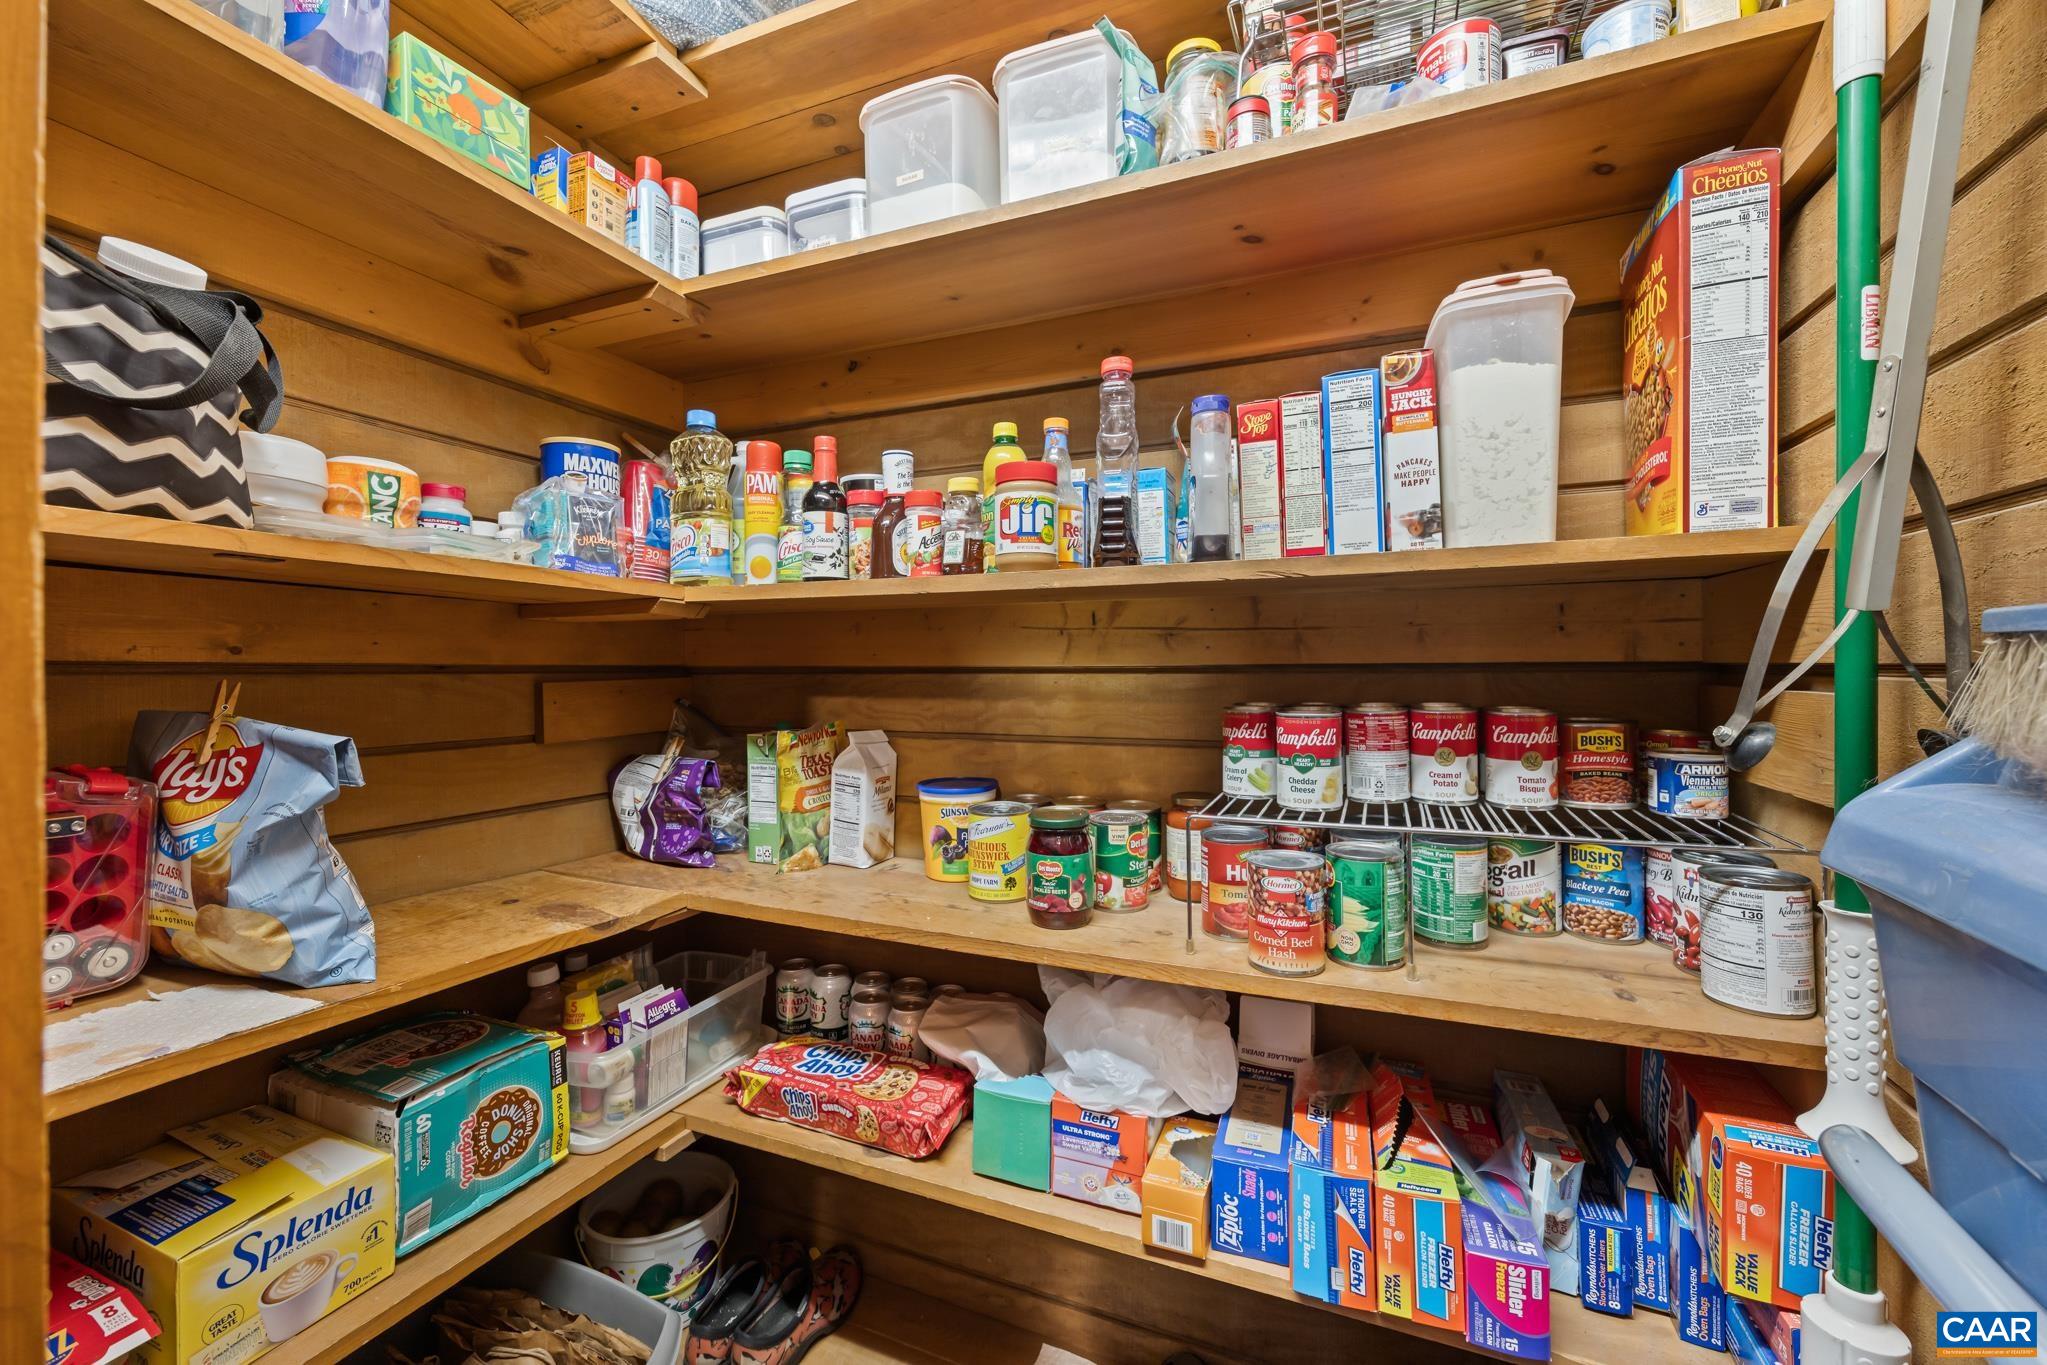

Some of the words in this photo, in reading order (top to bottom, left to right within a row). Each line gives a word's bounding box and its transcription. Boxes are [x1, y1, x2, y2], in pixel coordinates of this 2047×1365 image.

[1719, 164, 1745, 174] Honey
[1747, 160, 1763, 169] Nut
[1692, 168, 1768, 195] Cheerios
[1738, 213, 1750, 221] 140
[1757, 210, 1769, 219] 210
[1623, 276, 1667, 353] Cheerios
[1864, 292, 1880, 350] LIBMAN
[1391, 388, 1432, 401] HUNGRY
[1330, 404, 1353, 412] Calories
[1358, 399, 1372, 408] 200
[1241, 411, 1272, 434] Stove
[1252, 424, 1269, 438] Top
[564, 453, 619, 477] MAXWE
[1396, 457, 1433, 470] PANCAKES
[1394, 472, 1411, 480] MAKE
[1412, 468, 1436, 478] PEOPLE
[1401, 478, 1431, 488] HAPPY
[589, 474, 619, 496] HOUS
[746, 474, 777, 494] PAM
[372, 473, 400, 528] ANG
[1002, 502, 1052, 534] Jif
[645, 550, 659, 559] 30
[779, 541, 802, 561] Crisc
[1412, 722, 1476, 747] Campbell's
[1581, 735, 1622, 747] BUSH'S
[800, 752, 832, 767] TEXAS
[1573, 754, 1629, 765] Homestyle
[157, 749, 247, 803] Lay's
[1429, 771, 1451, 780] Cream
[1453, 771, 1462, 780] of
[1681, 765, 1728, 775] ARMOU
[1288, 777, 1318, 786] Cheddar
[1433, 779, 1459, 788] Potato
[1517, 776, 1547, 784] Tomato
[1519, 784, 1546, 794] Bisque
[1681, 775, 1710, 786] Vienna
[1290, 786, 1316, 794] Cheese
[941, 808, 968, 818] SUNSW
[973, 860, 996, 870] STEW
[1570, 847, 1622, 868] BUSH'S
[1221, 889, 1249, 899] Toma
[1267, 881, 1298, 890] Hormel
[1566, 880, 1606, 894] Blackeye
[1608, 885, 1631, 898] Peas
[1676, 885, 1699, 902] Kidn
[1593, 898, 1615, 907] BACON
[1257, 914, 1276, 928] Mary
[1741, 910, 1764, 920] 130
[1253, 931, 1288, 947] Corned
[1291, 935, 1314, 948] Beef
[1268, 948, 1296, 960] Hash
[648, 1000, 676, 1019] Allegra
[806, 1044, 871, 1065] Chips
[554, 1050, 563, 1085] KEURIG
[556, 1093, 563, 1105] 60
[783, 1087, 811, 1106] Chips
[416, 1113, 432, 1134] 60
[491, 1104, 526, 1126] DONUT
[522, 1100, 534, 1136] ORIGINAL
[1082, 1111, 1117, 1128] Hefty
[479, 1121, 492, 1159] COFFEE
[1062, 1125, 1082, 1135] ULTRA
[1084, 1129, 1110, 1140] STRONG
[1062, 1136, 1090, 1145] Lavender
[457, 1113, 476, 1189] Regular
[493, 1129, 524, 1161] SHOP
[1062, 1141, 1080, 1149] Sweet
[1736, 1161, 1752, 1177] 40
[1242, 1169, 1257, 1199] Snack
[1401, 1183, 1438, 1193] Hefty.com
[1735, 1175, 1743, 1194] BAGS
[1357, 1188, 1365, 1229] STRONGER
[1383, 1194, 1395, 1208] 40
[1219, 1194, 1239, 1247] Ziploc
[1789, 1201, 1798, 1234] GALLON
[217, 1186, 373, 1289] Splenda
[273, 1249, 294, 1263] ZERO
[296, 1231, 329, 1250] CALORIE
[330, 1205, 373, 1232] SWEETENER
[366, 1226, 379, 1243] #1
[1483, 1222, 1497, 1248] GALLON
[1799, 1208, 1811, 1267] FREEZER
[1817, 1219, 1833, 1268] Hefty
[1788, 1235, 1797, 1267] SLIDER
[1351, 1250, 1364, 1294] Hefty
[1428, 1237, 1437, 1288] FREEZER
[1440, 1245, 1454, 1290] Hefty
[1646, 1255, 1656, 1275] Bags
[1735, 1253, 1746, 1290] PACK
[1496, 1262, 1507, 1304] Freezer
[1747, 1253, 1758, 1294] VALUE
[343, 1278, 362, 1293] 700
[1384, 1275, 1392, 1308] PACK
[1393, 1274, 1401, 1309] VALUE
[1508, 1265, 1526, 1317] Slider
[1646, 1277, 1656, 1300] Oven
[101, 1305, 119, 1318] 8
[1699, 1296, 1708, 1317] Bags
[208, 1310, 237, 1332] GREAT
[211, 1318, 238, 1339] TASTE
[1699, 1318, 1708, 1342] Oven
[1506, 1337, 1518, 1352] 15
